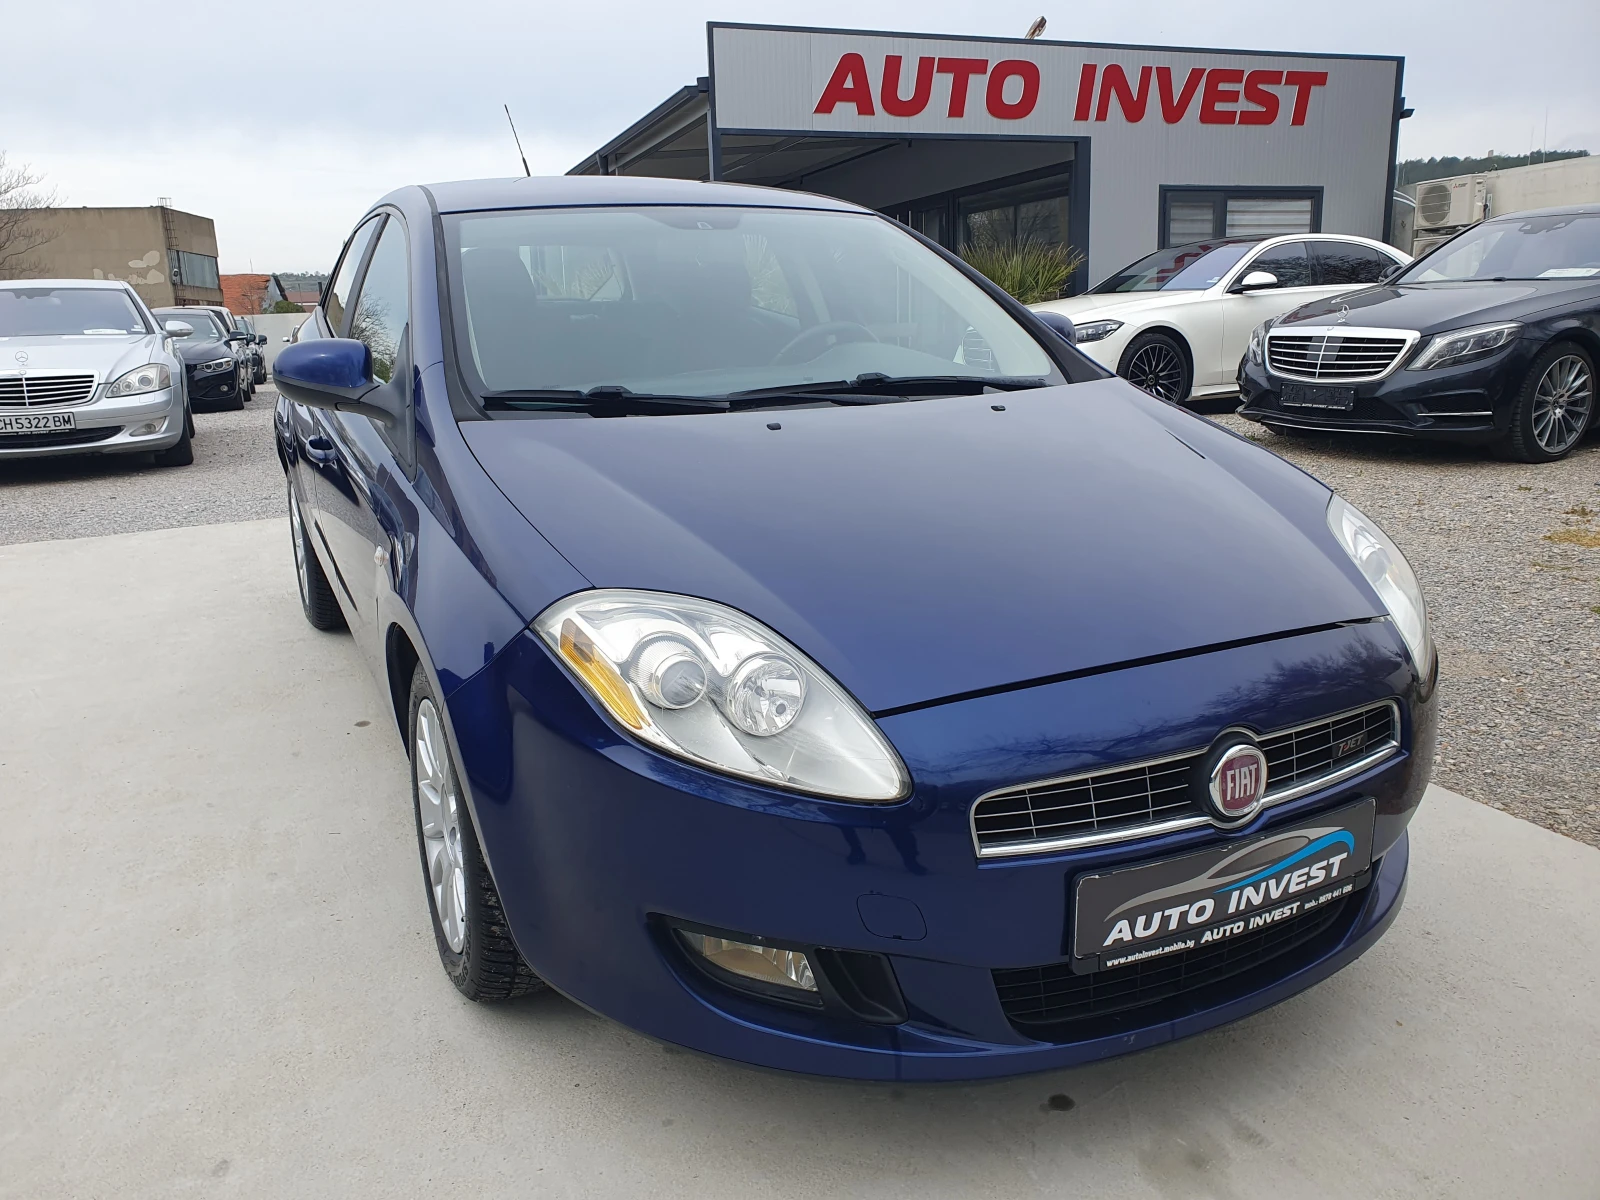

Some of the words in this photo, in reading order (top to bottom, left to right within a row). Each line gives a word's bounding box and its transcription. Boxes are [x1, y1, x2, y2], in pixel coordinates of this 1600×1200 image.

[812, 52, 1041, 121] AUTO
[1073, 63, 1329, 126] INVEST
[15, 416, 51, 429] 5322
[53, 415, 72, 427] BM
[1226, 764, 1258, 801] FIAT
[1102, 898, 1215, 947] AUTO
[1227, 852, 1348, 914] INVEST
[1106, 939, 1195, 967] www.autoinvest.mobile.bg
[1200, 921, 1245, 944] AUTO
[1249, 901, 1301, 930] INVEST
